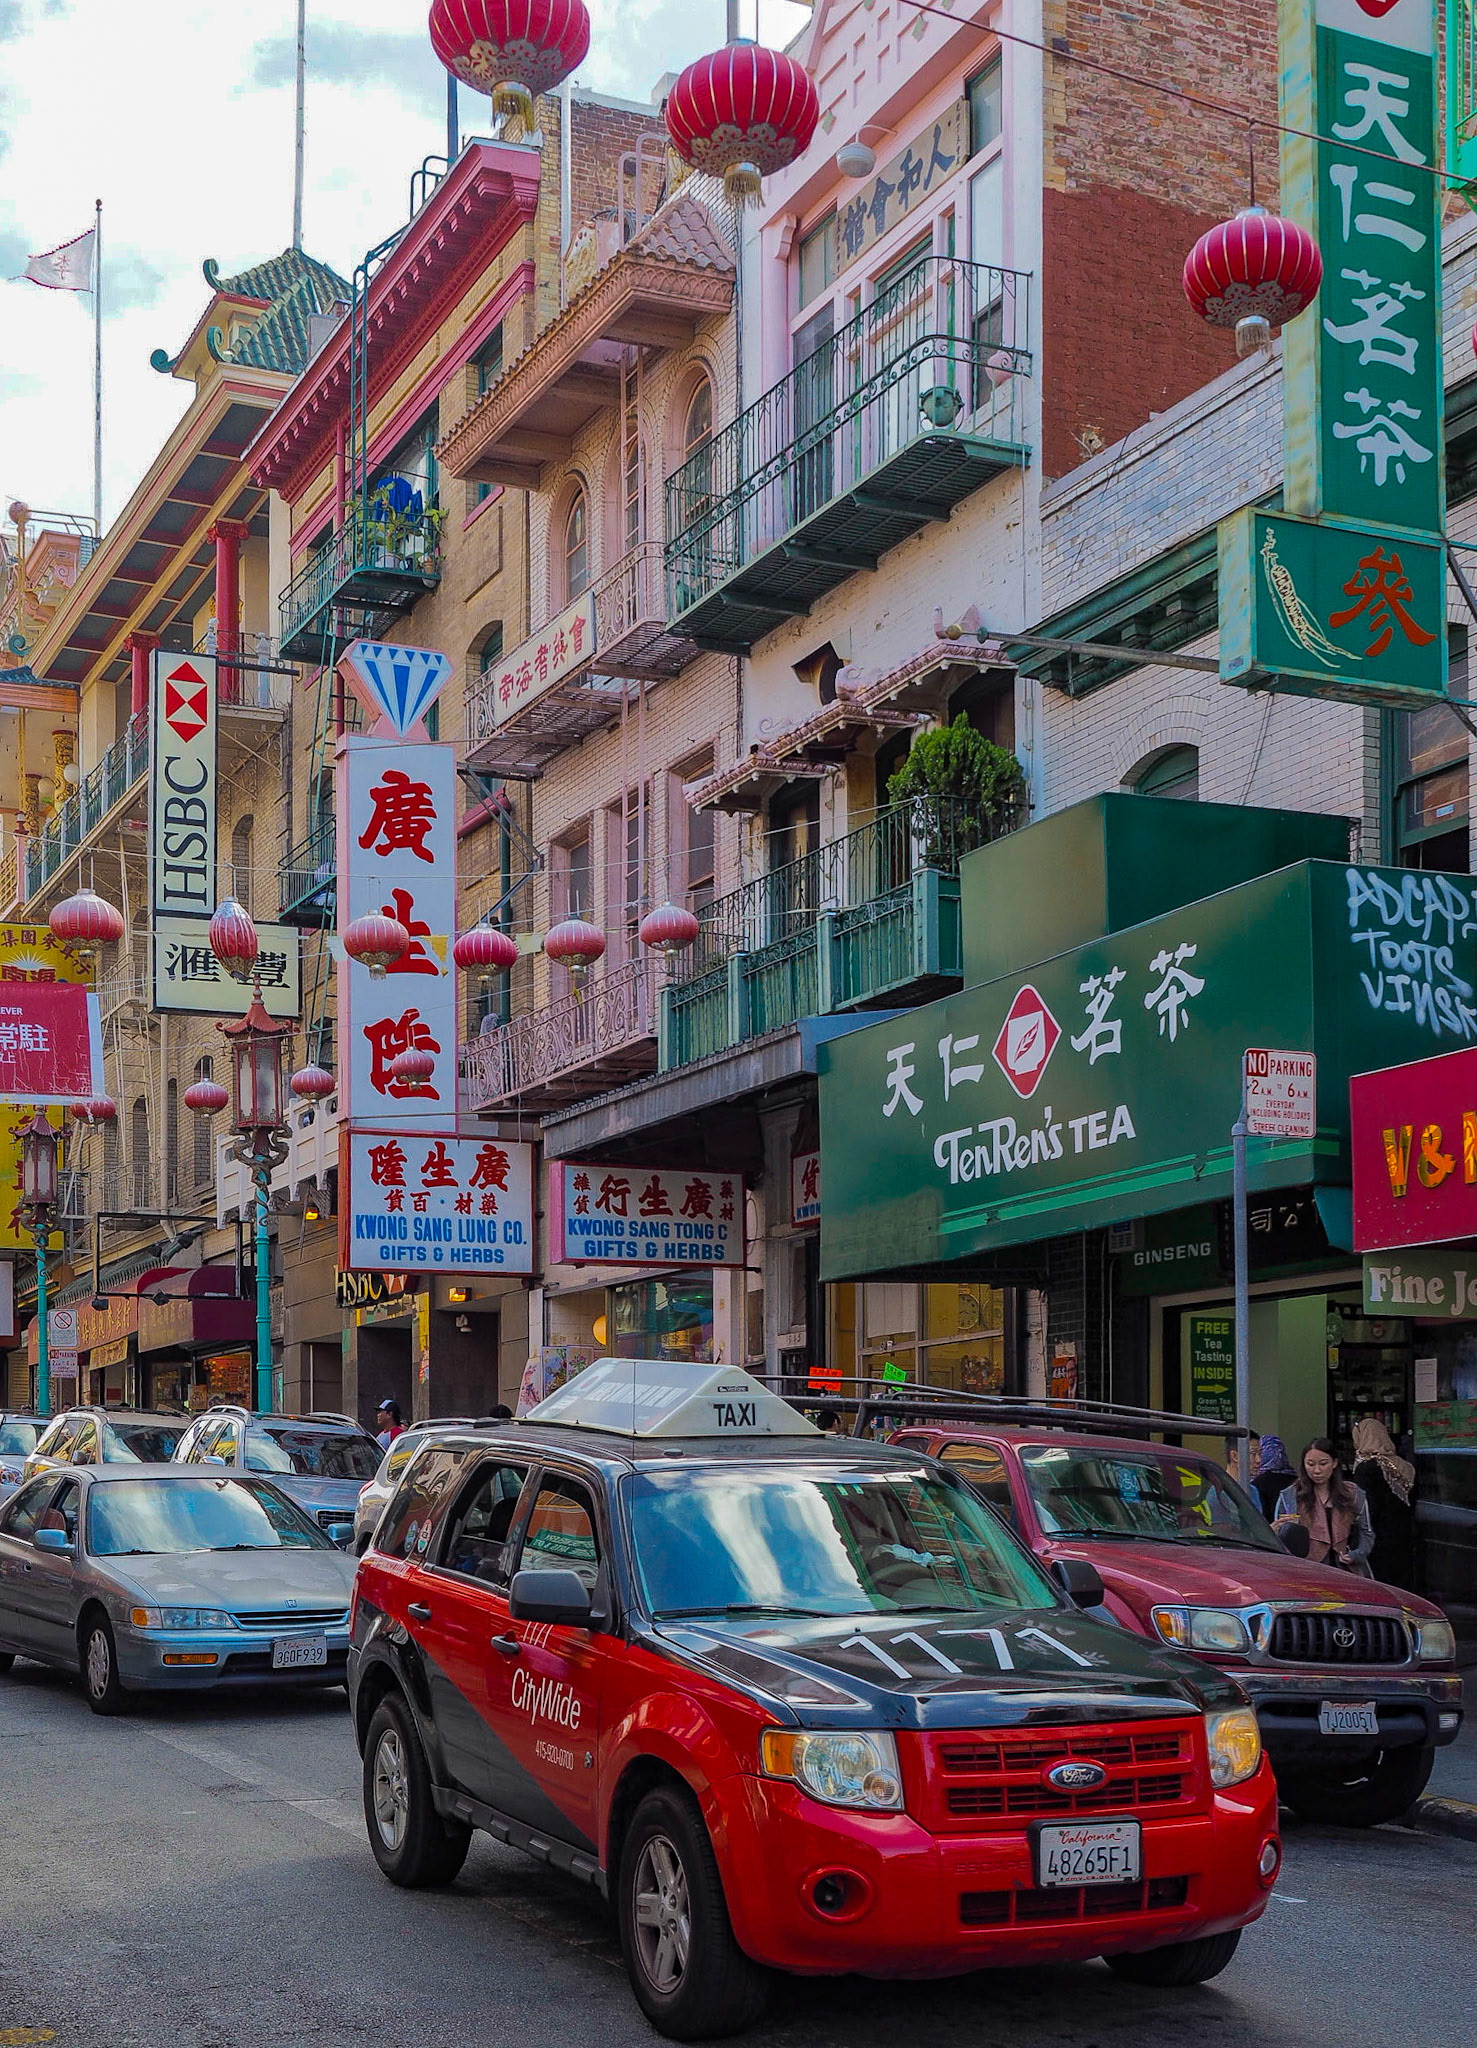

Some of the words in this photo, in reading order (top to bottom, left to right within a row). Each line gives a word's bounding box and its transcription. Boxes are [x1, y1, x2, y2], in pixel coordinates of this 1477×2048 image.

[1322, 62, 1436, 486] 天仁茗茶
[163, 756, 209, 906] HSBC
[1248, 1053, 1267, 1074] NO
[1270, 1059, 1312, 1077] PARKING
[1251, 1080, 1259, 1095] 2
[1287, 1083, 1295, 1097] 6
[1251, 1109, 1281, 1118] INCLUDING
[1283, 1111, 1311, 1120] HOLIDAYS
[1266, 1100, 1295, 1109] EVERYDAY
[1068, 1104, 1137, 1154] TEA
[1253, 1122, 1275, 1132] STREET
[1277, 1124, 1309, 1134] CLEANING
[1382, 1124, 1415, 1198] V
[1417, 1124, 1457, 1188] &
[355, 1215, 408, 1241] KWONG
[413, 1217, 452, 1243] SANG
[458, 1219, 497, 1244] LUNG
[503, 1221, 527, 1246] CO.
[568, 1218, 624, 1237] KWONG
[629, 1220, 670, 1238] SANG
[674, 1222, 714, 1239] TONG
[718, 1224, 728, 1240] C
[380, 1245, 427, 1262] GIFTS
[433, 1249, 444, 1262] &
[450, 1248, 505, 1263] HERBS
[584, 1240, 638, 1258] GIFTS
[645, 1243, 658, 1258] &
[664, 1242, 725, 1260] HERBS
[1134, 1242, 1212, 1266] GINSENG
[1369, 1266, 1445, 1305] Fine
[1196, 1321, 1230, 1335] FREE
[1203, 1338, 1222, 1350] Tea
[1195, 1351, 1232, 1365] Tasting
[1193, 1367, 1233, 1380] INSIDE
[713, 1403, 756, 1427] TAXI
[839, 1627, 1094, 1680] 1171
[511, 1667, 582, 1730] CityWide
[1322, 1711, 1373, 1729] 7J20057
[1061, 1830, 1121, 1847] California
[1047, 1846, 1133, 1876] 48265F1
